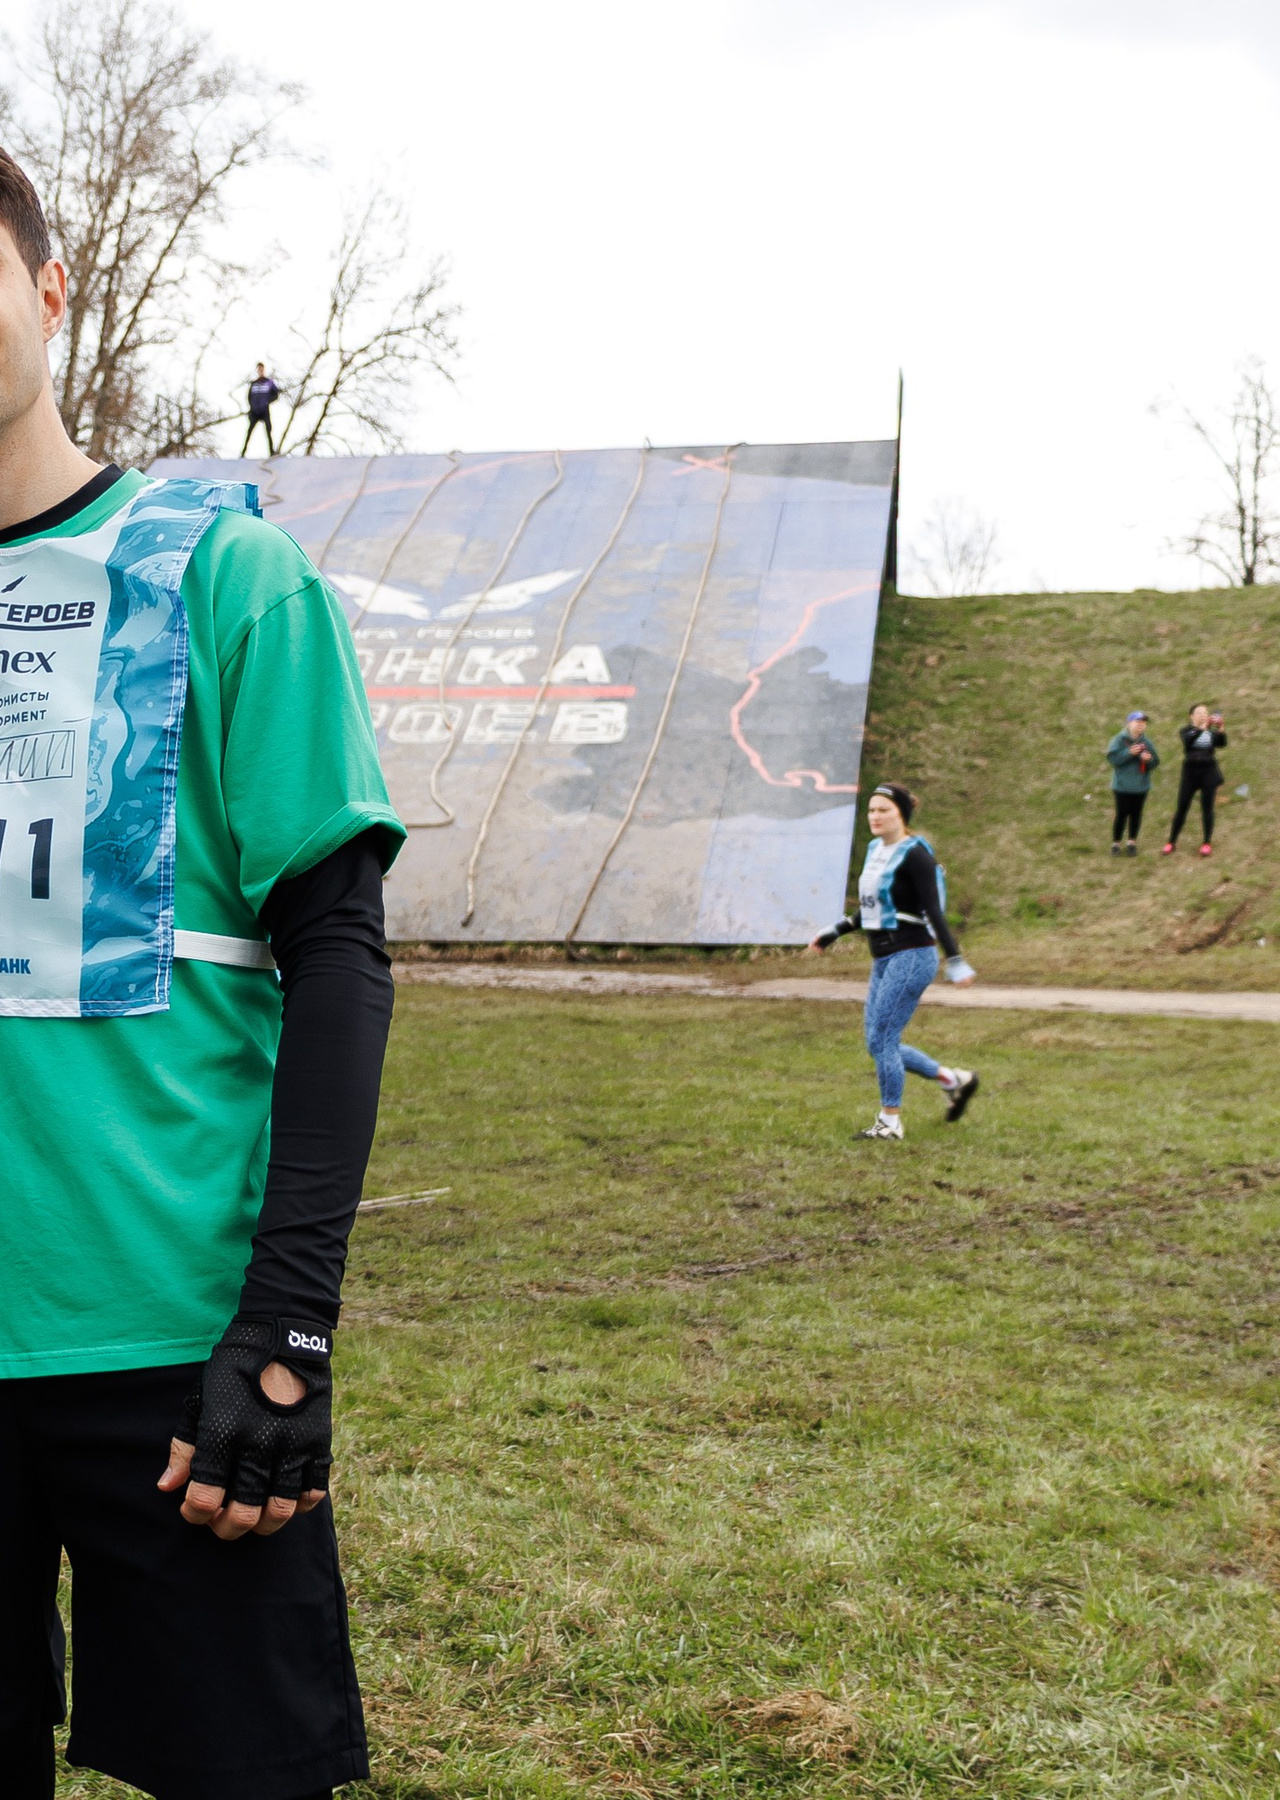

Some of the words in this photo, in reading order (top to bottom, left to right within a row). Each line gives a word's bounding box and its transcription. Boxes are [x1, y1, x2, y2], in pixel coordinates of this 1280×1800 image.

[357, 644, 612, 685] НКА
[370, 701, 629, 745] ОЕВ
[288, 1330, 328, 1353] TORQ
